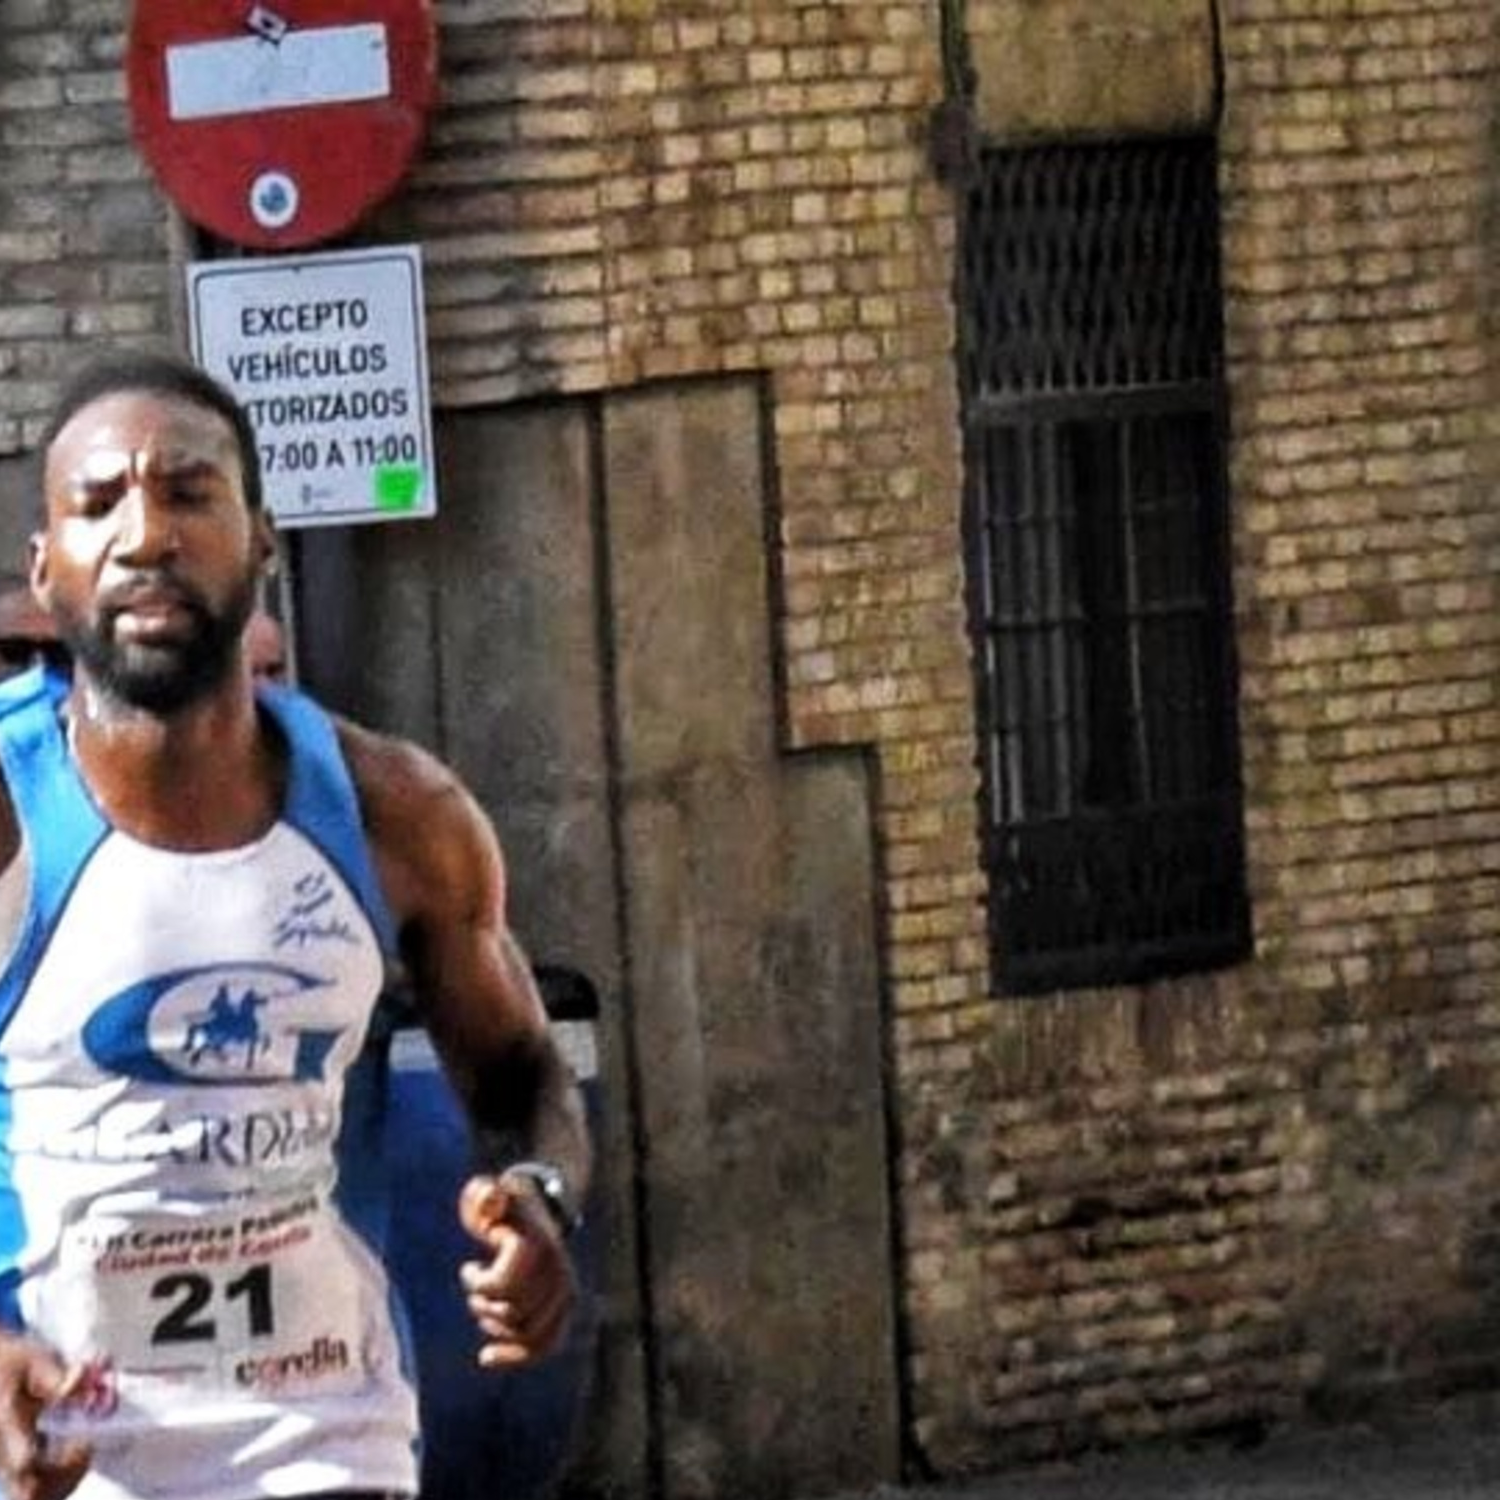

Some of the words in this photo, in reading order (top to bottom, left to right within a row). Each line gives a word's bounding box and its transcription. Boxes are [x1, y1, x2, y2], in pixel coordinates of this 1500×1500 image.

[240, 299, 368, 337] EXCEPTO
[228, 342, 388, 382] VEHÍCULOS
[248, 388, 409, 428] TORIZADOS
[260, 441, 319, 473] 7:00
[325, 439, 346, 468] A
[352, 434, 418, 466] 11:00
[150, 1262, 275, 1345] 21
